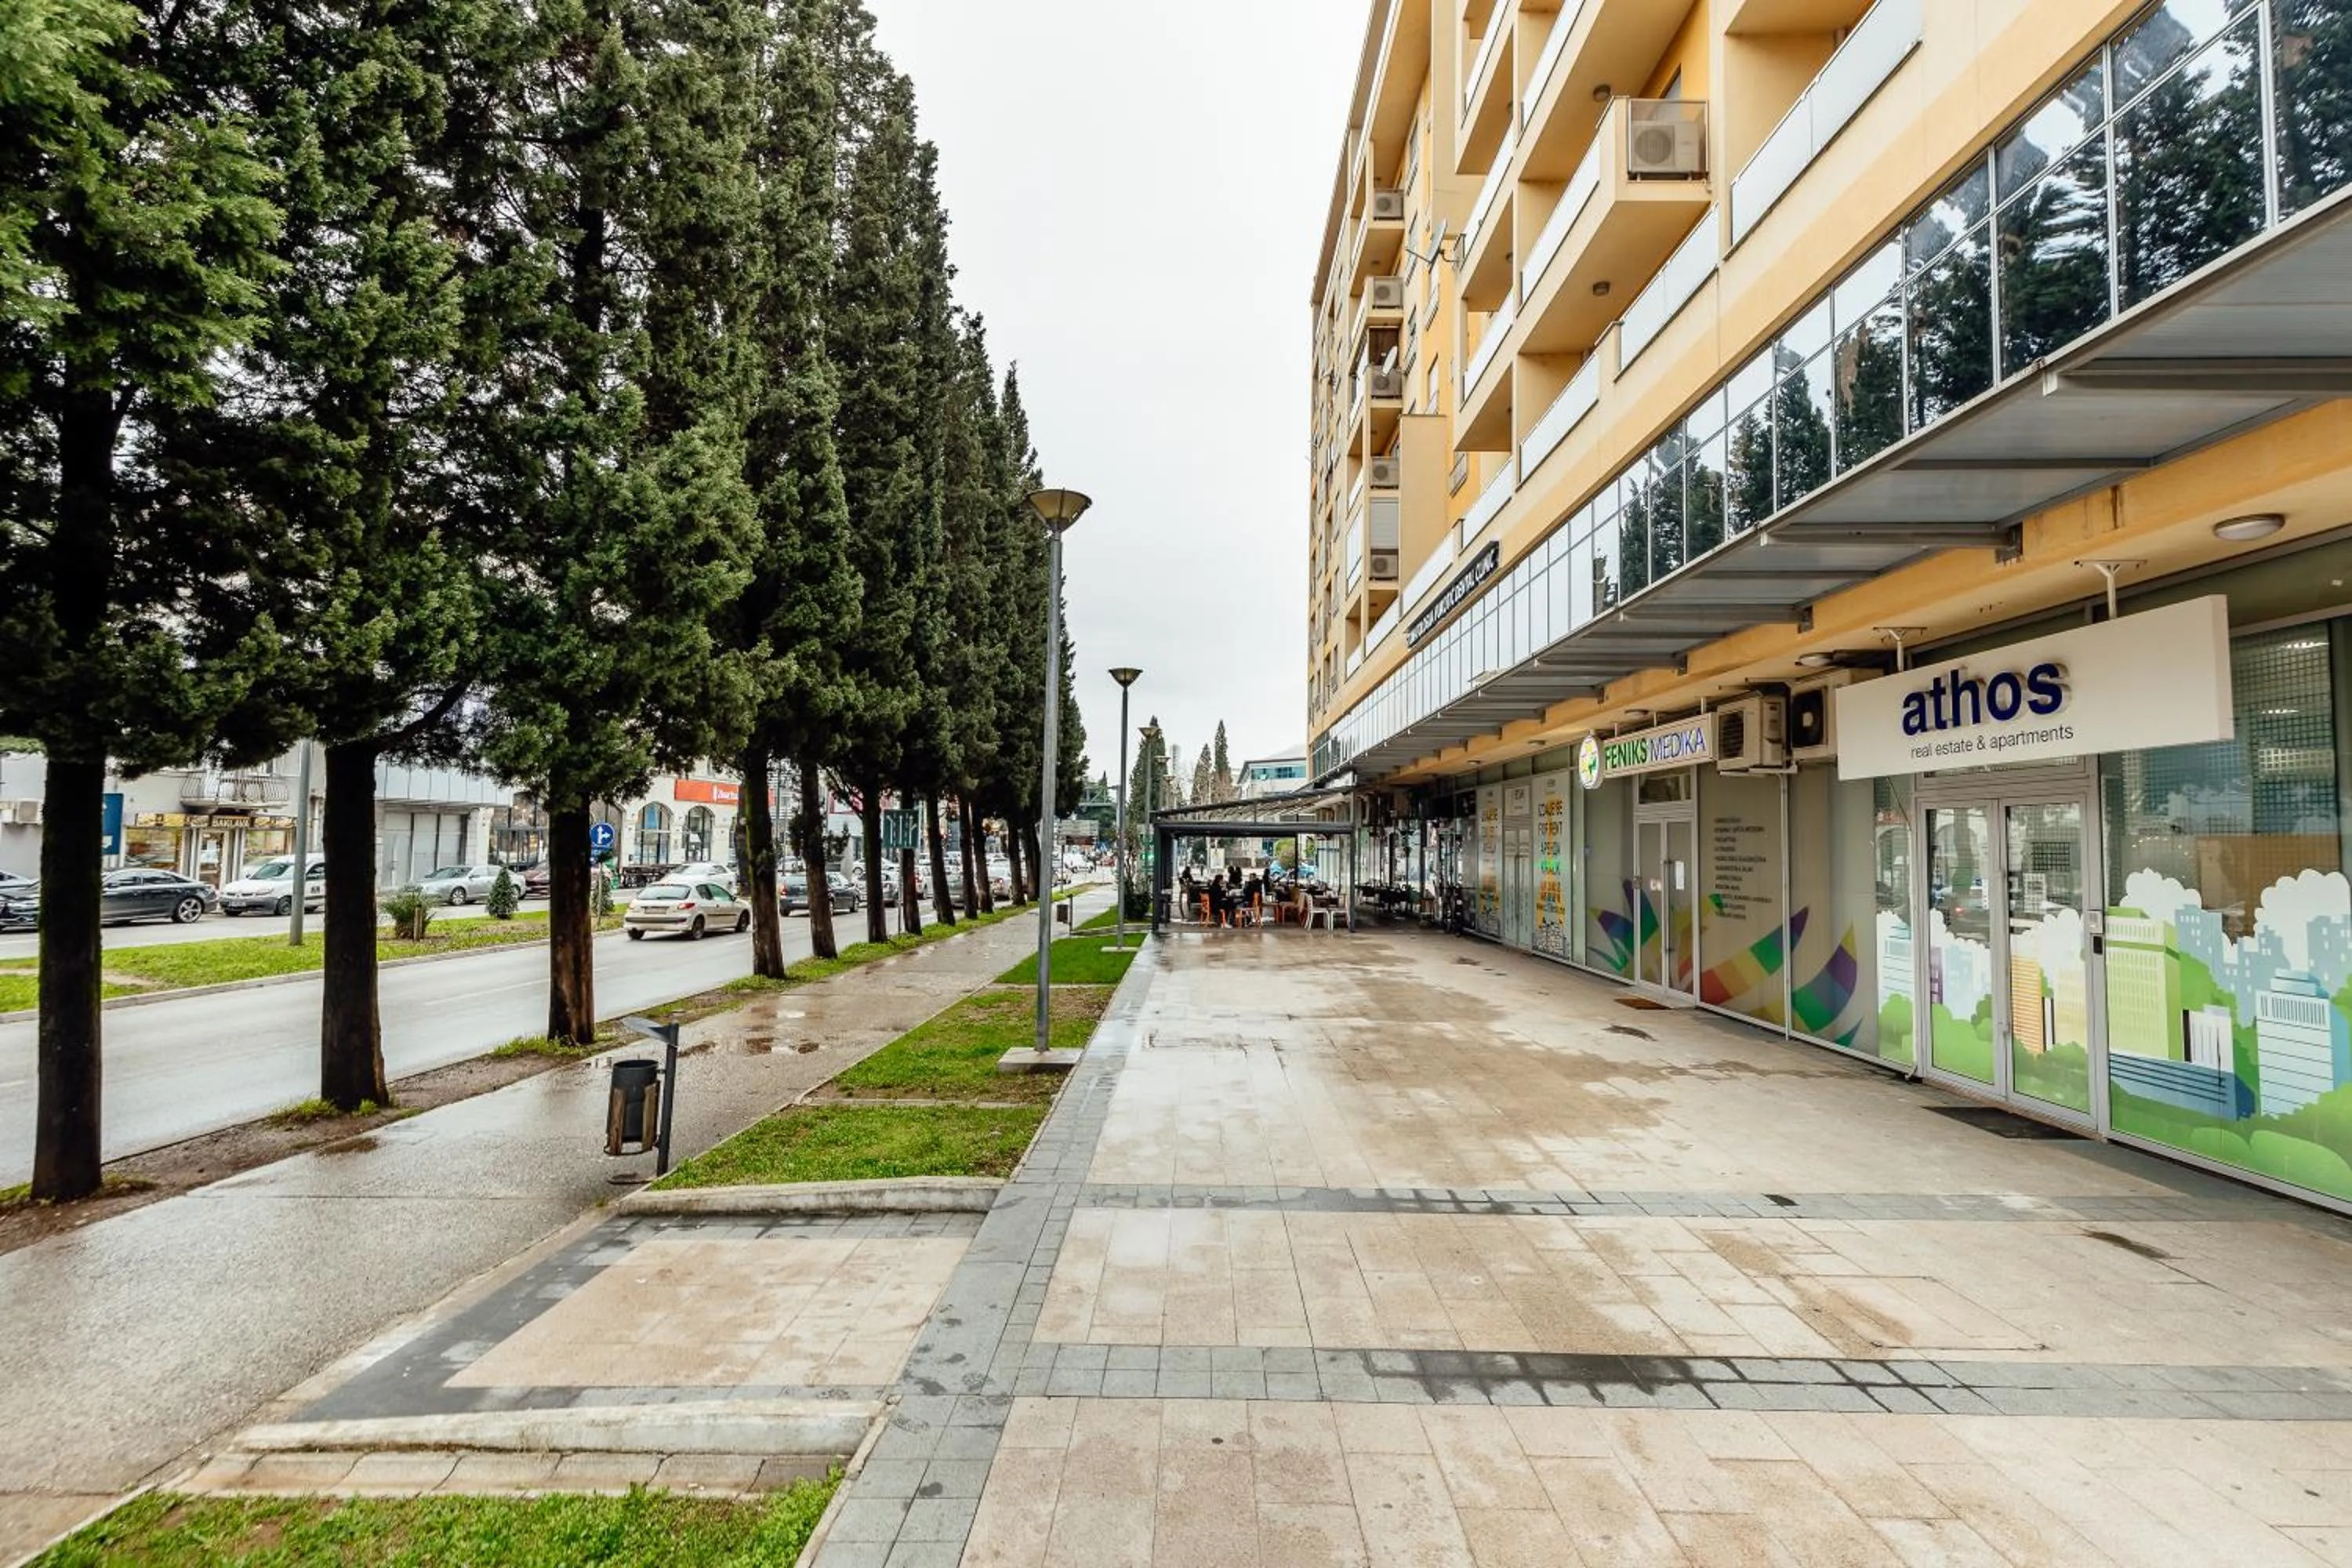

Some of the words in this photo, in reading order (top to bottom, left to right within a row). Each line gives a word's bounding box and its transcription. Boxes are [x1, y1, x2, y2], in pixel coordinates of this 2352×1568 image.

[1902, 663, 2063, 736] athos
[1604, 738, 1646, 770] FENIKS
[1650, 727, 1706, 761] MEDIKA
[1911, 742, 1933, 758] real
[1935, 739, 1973, 757] estate
[1976, 735, 1986, 750] &
[1989, 724, 2074, 751] apartments
